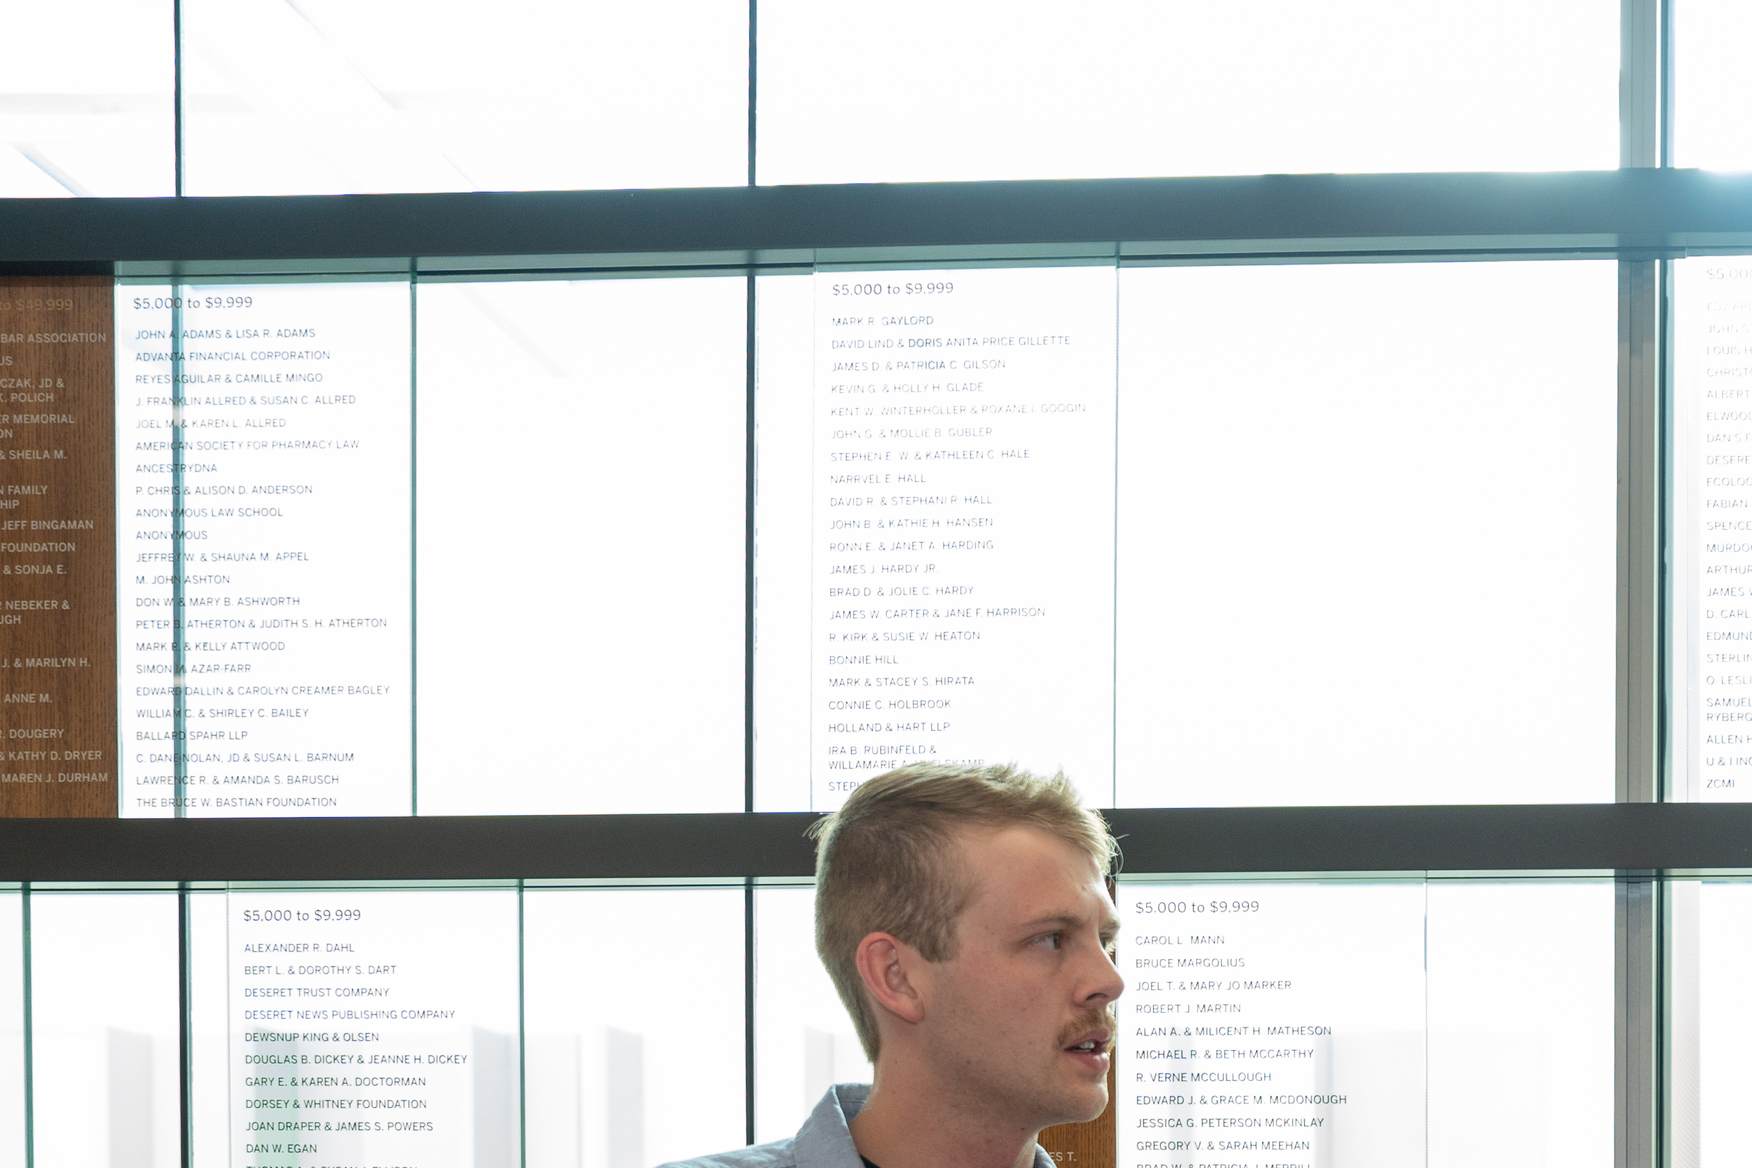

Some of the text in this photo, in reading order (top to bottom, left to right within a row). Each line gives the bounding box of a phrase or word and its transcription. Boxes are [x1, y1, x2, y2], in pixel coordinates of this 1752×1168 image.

[832, 282, 954, 295] $5,000 to $9,999
[133, 297, 253, 309] $5,000 to $9,999
[1, 333, 107, 343] BAR ASSOCIATION
[135, 351, 331, 361] ADVANTA FINANCIAL CORPORATION
[136, 464, 218, 473] ANCESTRYDNA
[1, 520, 94, 530] JEFF BINGAMAN
[1, 542, 76, 552] FOUNDATION
[828, 655, 899, 664] BONNIE HILL
[828, 700, 952, 710] CONNIE C. HOLBROOK
[1706, 713, 1752, 721] RYBERG
[136, 731, 248, 740] BALLARD SPAHR LLP
[2, 773, 108, 783] MAREN J. DURHAM
[1706, 779, 1735, 788] ZCMI
[1135, 901, 1260, 913] $5,000 to $9,999
[243, 909, 361, 921] $5,000 to $9,999
[1135, 958, 1245, 968] BRUCE MARGOLIUS
[245, 1010, 455, 1019] DESERET NEWS PUBLISHING COMPANY
[1137, 1118, 1324, 1128] JESSICA G. PETERSON MCKINLAY
